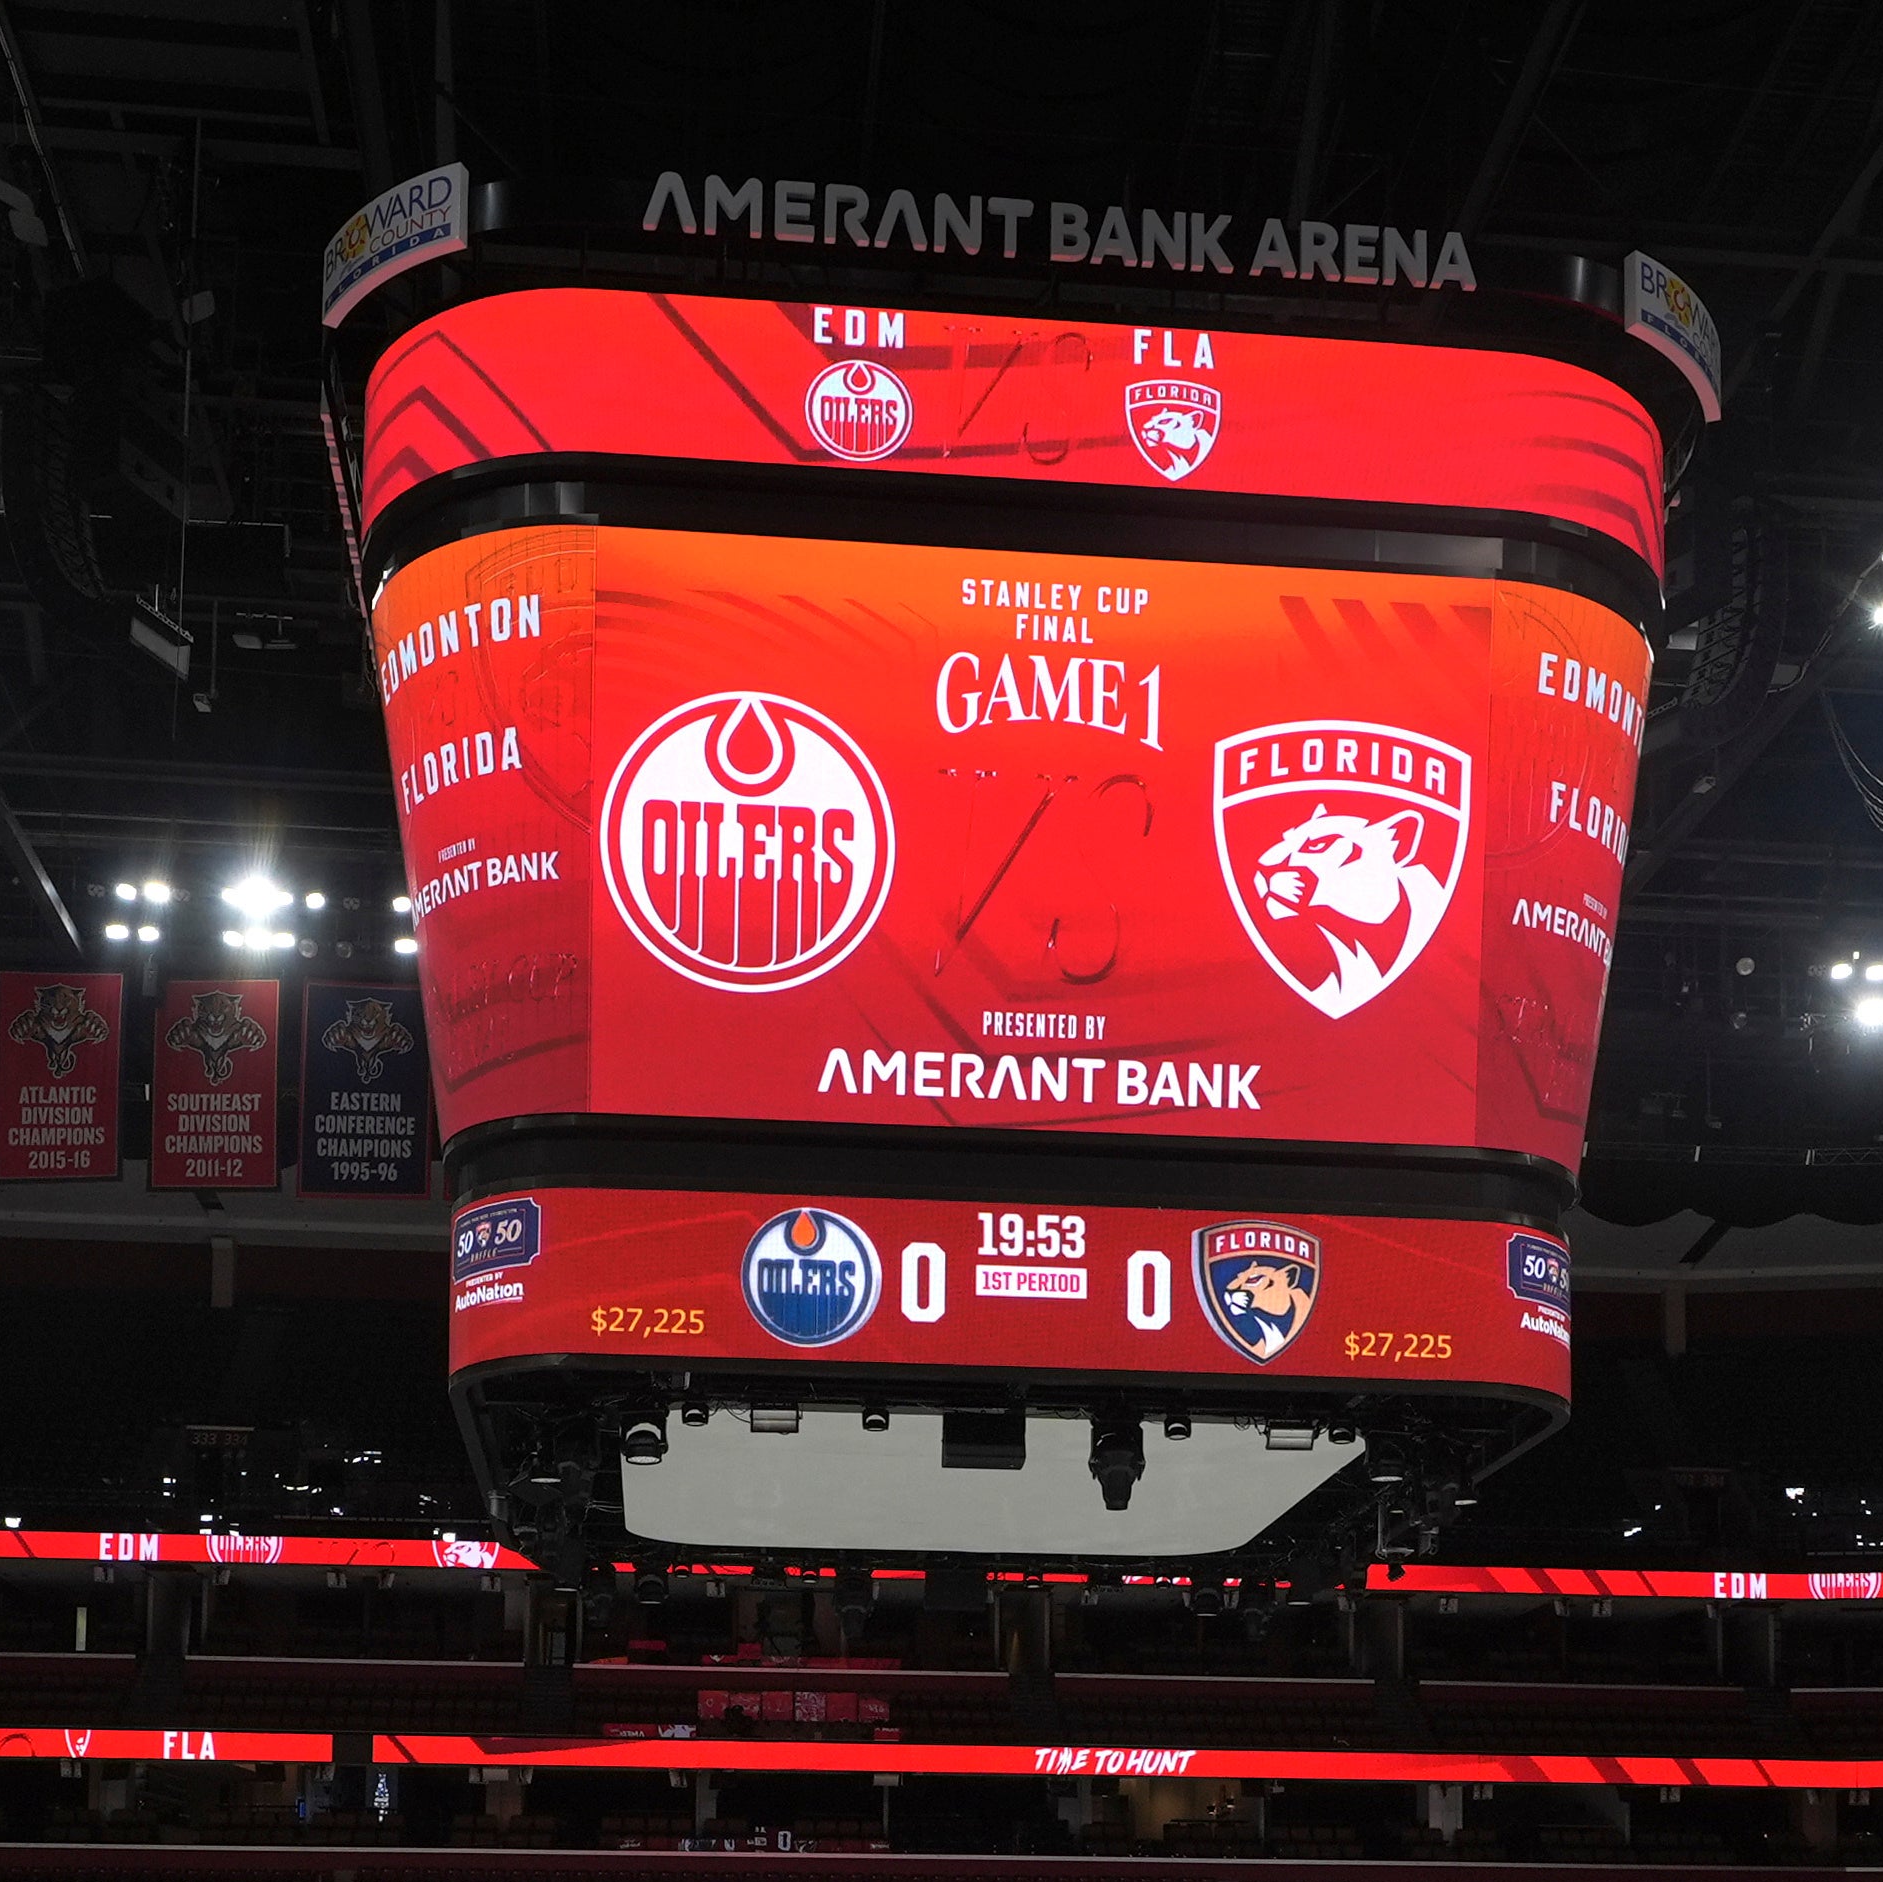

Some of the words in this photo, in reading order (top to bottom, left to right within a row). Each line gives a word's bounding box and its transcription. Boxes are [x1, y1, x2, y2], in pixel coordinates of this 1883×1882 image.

[369, 205, 452, 254] COUNTY
[642, 171, 1034, 259] AMERANT
[1050, 202, 1234, 274] BANK
[1249, 218, 1478, 292] ARENA
[813, 306, 904, 350] EDM
[1132, 328, 1215, 370] FLA
[1134, 386, 1214, 406] FLORIDA
[820, 394, 898, 438] OILERS
[961, 578, 1082, 612] STANLEY
[1097, 587, 1149, 615] CUP
[1016, 613, 1094, 645] FINAL
[380, 593, 542, 707] EDMONTON
[935, 651, 1128, 735] GAME
[1139, 664, 1164, 752] 1
[400, 726, 523, 816] FLORIDA
[1238, 737, 1448, 796] FLORIDA
[486, 850, 560, 887] BANK
[641, 799, 855, 925] OILERS
[982, 1011, 1077, 1040] PRESENTED
[1085, 1016, 1106, 1041] BY
[818, 1047, 1106, 1103] AMERANT
[1116, 1058, 1262, 1110] BANK
[18, 1086, 97, 1105] ATLANTIC
[166, 1092, 262, 1113] SOUTHEAST
[330, 1091, 402, 1112] EASTERN
[20, 1106, 94, 1126] DIVISION
[177, 1113, 250, 1133] DIVISION
[315, 1114, 416, 1137] CONFERENCE
[8, 1126, 105, 1147] CHAMPIONS
[165, 1134, 263, 1155] CHAMPIONS
[316, 1138, 412, 1159] CHAMPIONS
[28, 1150, 91, 1170] 2015-16
[185, 1158, 244, 1178] 2011-12
[330, 1161, 399, 1182] 1995-96
[457, 1230, 474, 1258] 50
[494, 1219, 523, 1246] 50
[977, 1211, 1086, 1259] 19:53
[1215, 1231, 1311, 1258] FLORIDA
[981, 1270, 1015, 1291] 1ST
[1017, 1271, 1081, 1294] PERIOD
[1523, 1254, 1546, 1279] 50
[454, 1282, 525, 1313] AutoNation
[757, 1257, 856, 1316] OILERS
[900, 1242, 946, 1323] 0
[1127, 1249, 1171, 1331] 0
[590, 1306, 705, 1338] $27,225
[1344, 1330, 1453, 1363] $27,225
[98, 1533, 159, 1563] EDM
[1714, 1572, 1768, 1599] EDM
[163, 1731, 216, 1760] FLA
[1095, 1750, 1123, 1774] TO
[1125, 1749, 1197, 1776] HUNT
